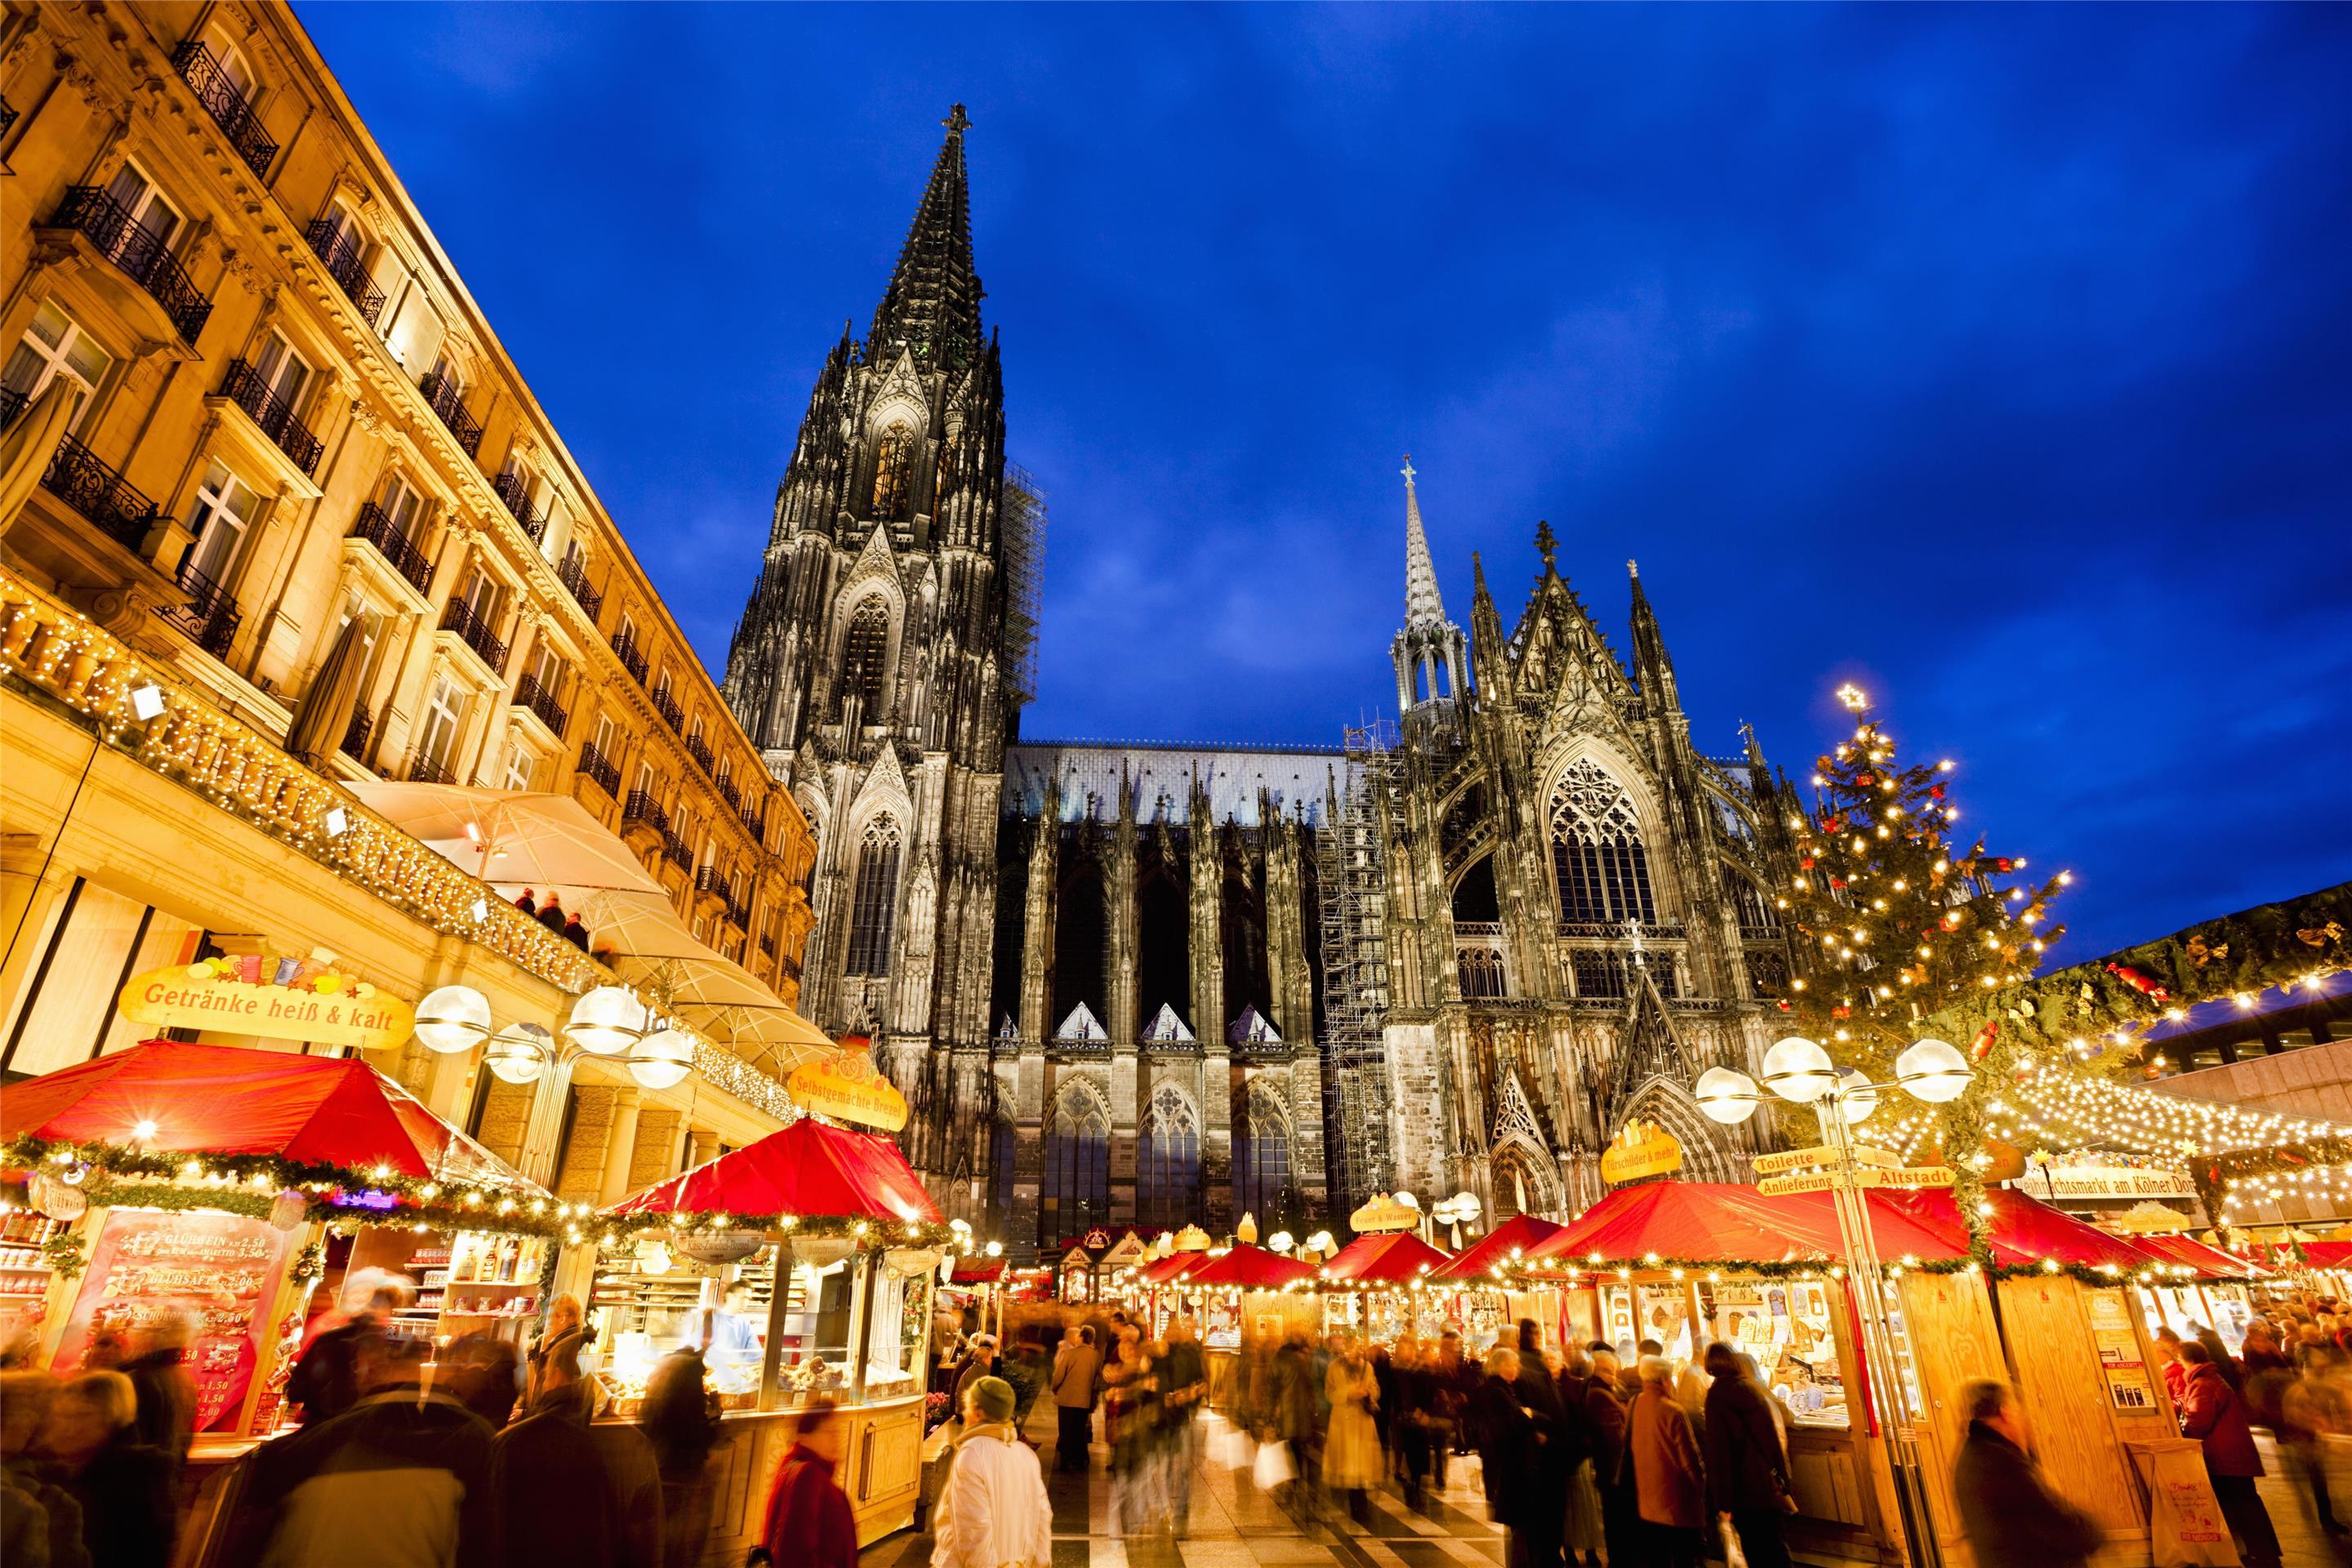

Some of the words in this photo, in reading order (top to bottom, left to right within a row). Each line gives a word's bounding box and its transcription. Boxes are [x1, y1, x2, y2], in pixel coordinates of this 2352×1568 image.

[144, 983, 258, 1015] Getränke
[268, 999, 318, 1022] heiß
[327, 1005, 342, 1025] &
[349, 1009, 394, 1031] kalt
[796, 1076, 871, 1110] Selbstgemachte
[874, 1097, 902, 1118] Brezel
[1606, 1153, 1646, 1172] Türschilder
[1647, 1150, 1654, 1163] &
[1655, 1146, 1675, 1161] mehr
[1757, 1152, 1815, 1171] Toilette
[1764, 1177, 1833, 1195] Anlieferung
[1880, 1170, 1949, 1185] Altstadt
[2112, 1181, 2132, 1194] am
[2133, 1176, 2171, 1194] Kölner
[1356, 1216, 1374, 1224] Feuer
[1385, 1213, 1412, 1222] Wasser
[165, 1233, 227, 1246] GLÜHWEIN
[241, 1237, 265, 1249] 2,50
[228, 1276, 253, 1288] 2,00
[217, 1312, 243, 1324] 2,50
